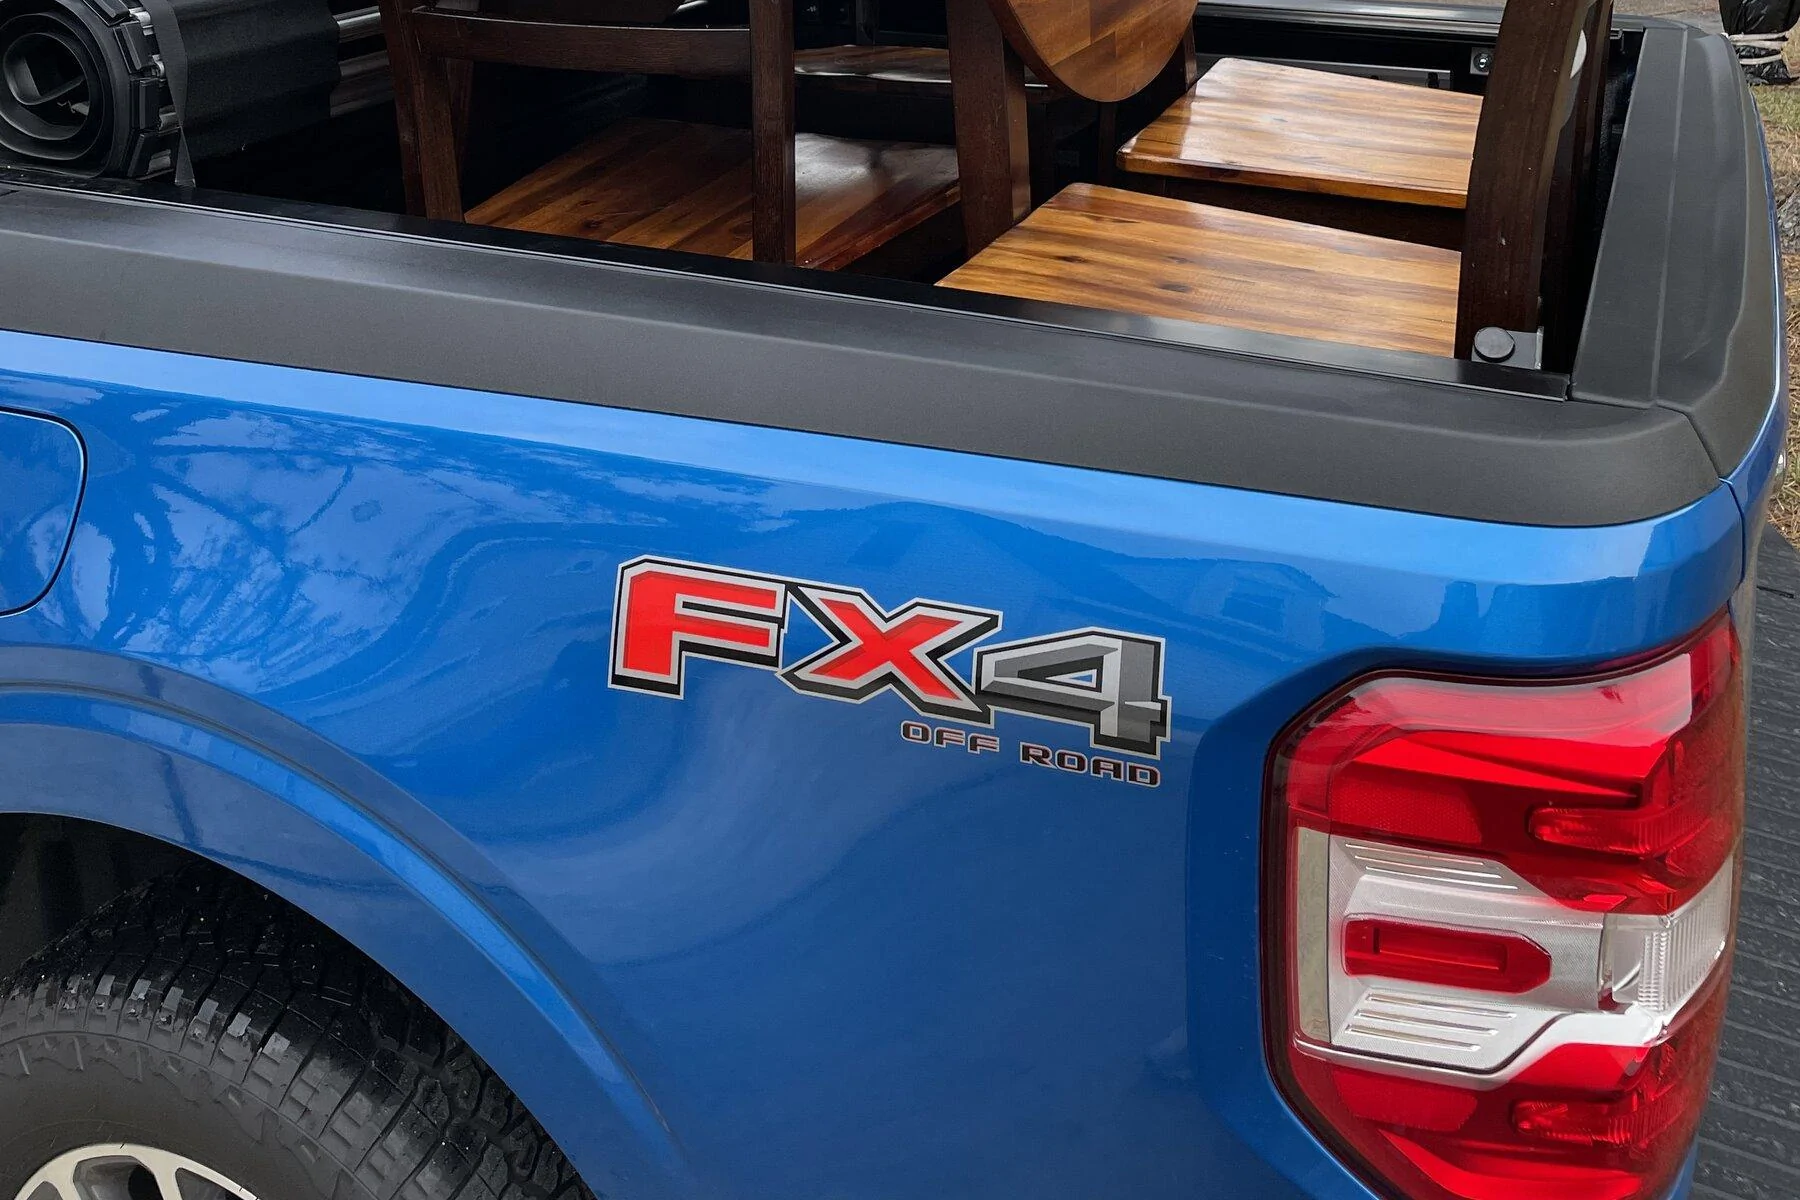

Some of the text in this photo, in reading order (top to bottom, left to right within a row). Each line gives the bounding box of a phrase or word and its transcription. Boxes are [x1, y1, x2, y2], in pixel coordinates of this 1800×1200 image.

[609, 555, 1171, 760] FX4
[901, 720, 1161, 787] OFF ROAD
